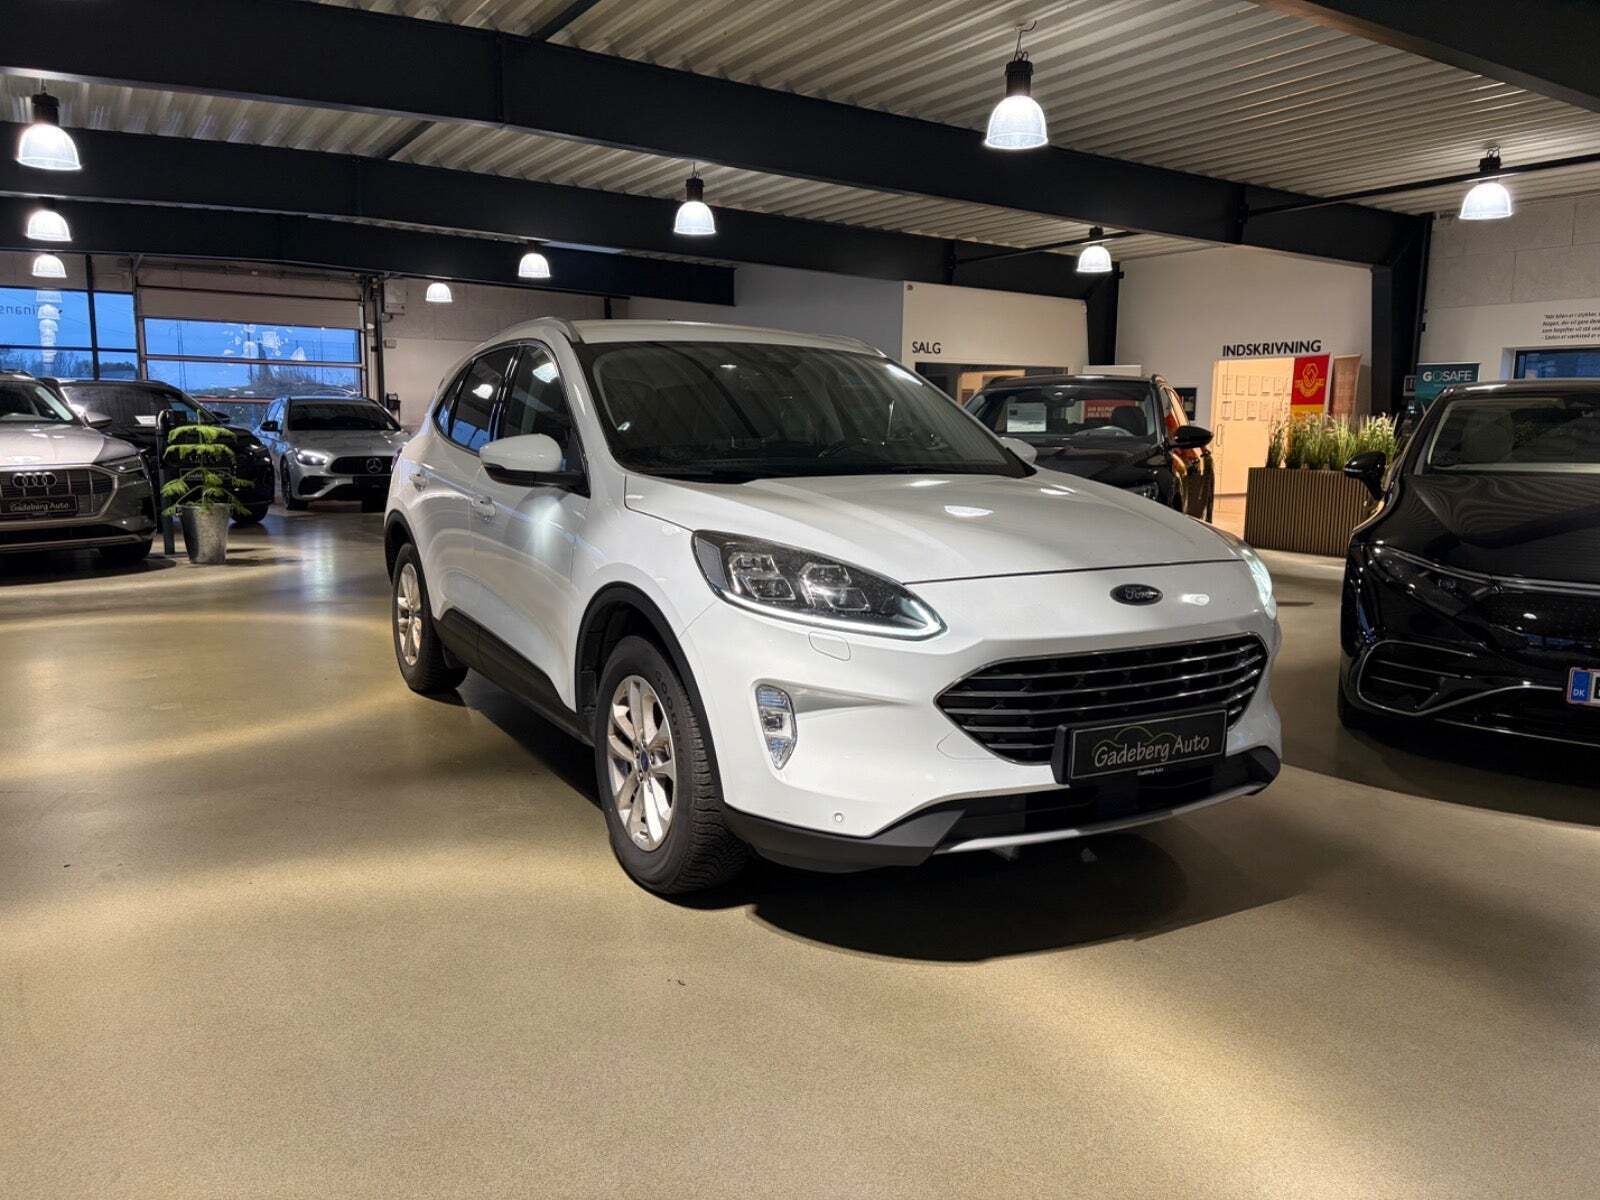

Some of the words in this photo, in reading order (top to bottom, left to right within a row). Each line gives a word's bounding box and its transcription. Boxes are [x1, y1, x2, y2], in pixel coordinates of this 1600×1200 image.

[912, 341, 941, 354] SALG
[1222, 340, 1322, 357] INDSKRIVNING
[1573, 688, 1585, 697] DK
[1094, 742, 1170, 768] Gadeberg
[1171, 735, 1210, 755] Auto
